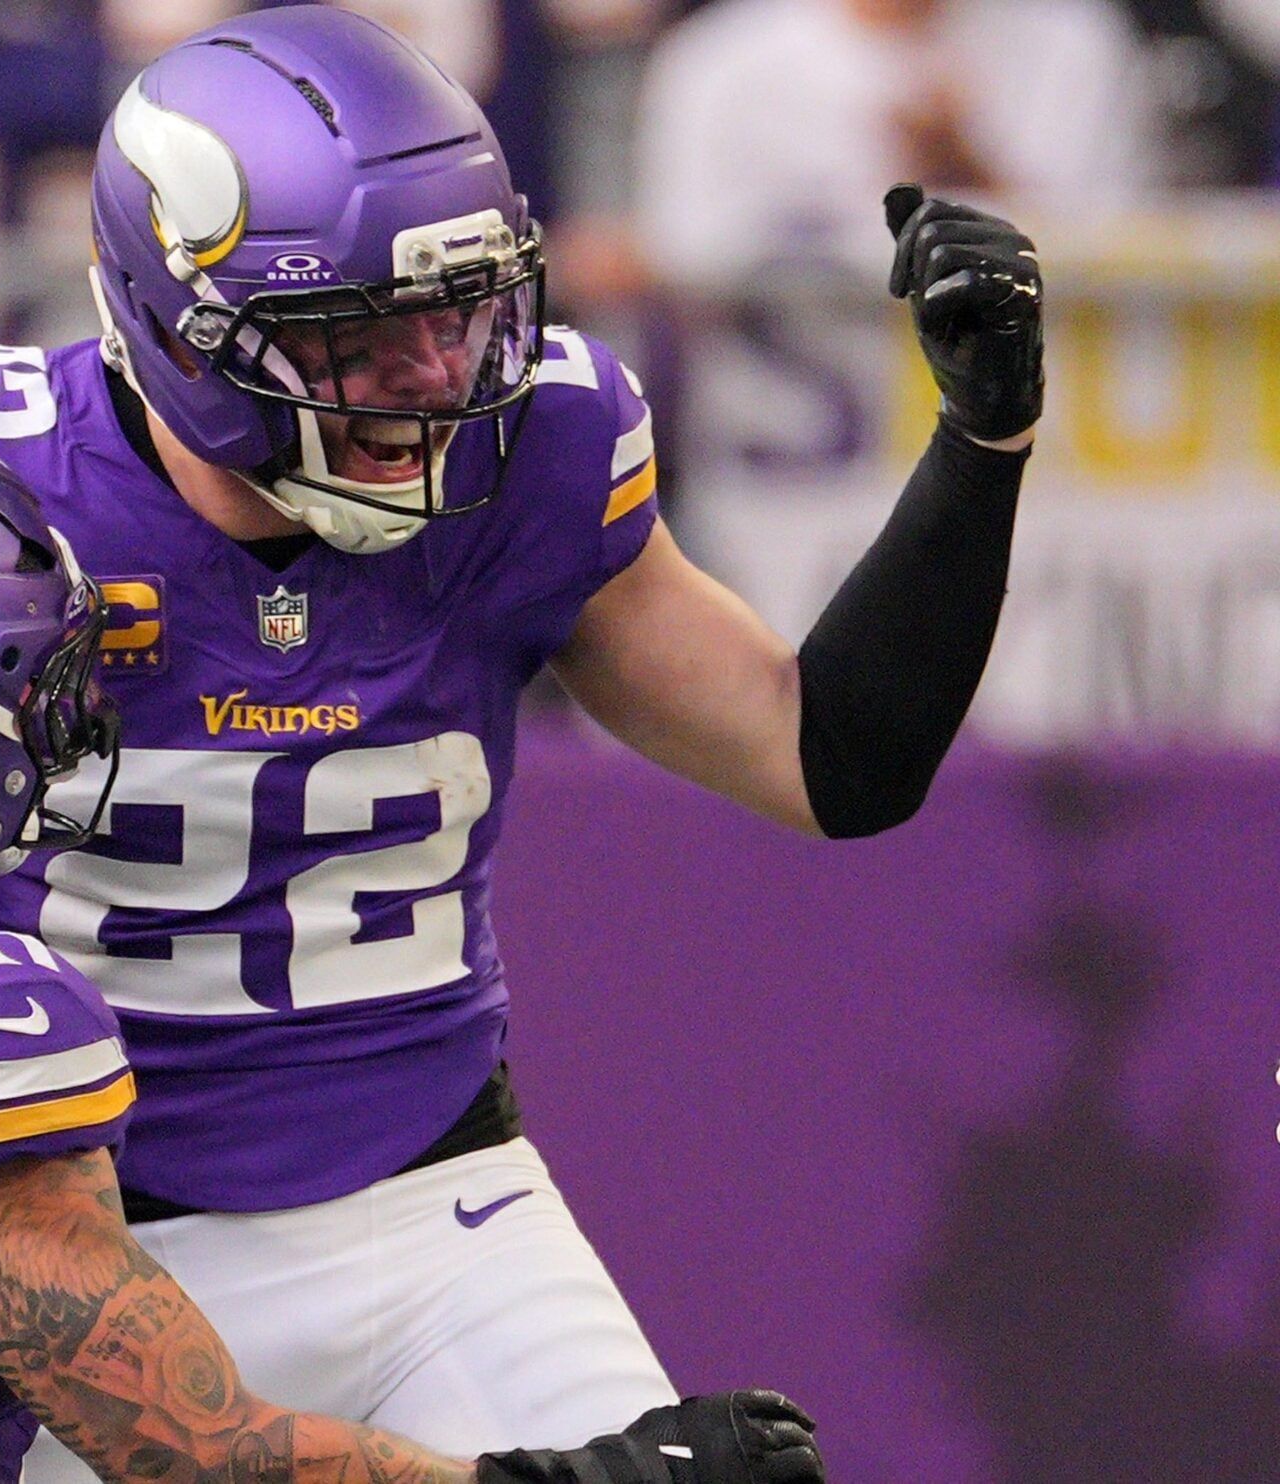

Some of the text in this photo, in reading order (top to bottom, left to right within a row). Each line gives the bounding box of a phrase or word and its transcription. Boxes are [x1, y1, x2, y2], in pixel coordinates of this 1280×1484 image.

[266, 271, 335, 281] OAKLEY
[267, 617, 303, 641] NFL
[39, 731, 492, 1016] 22
